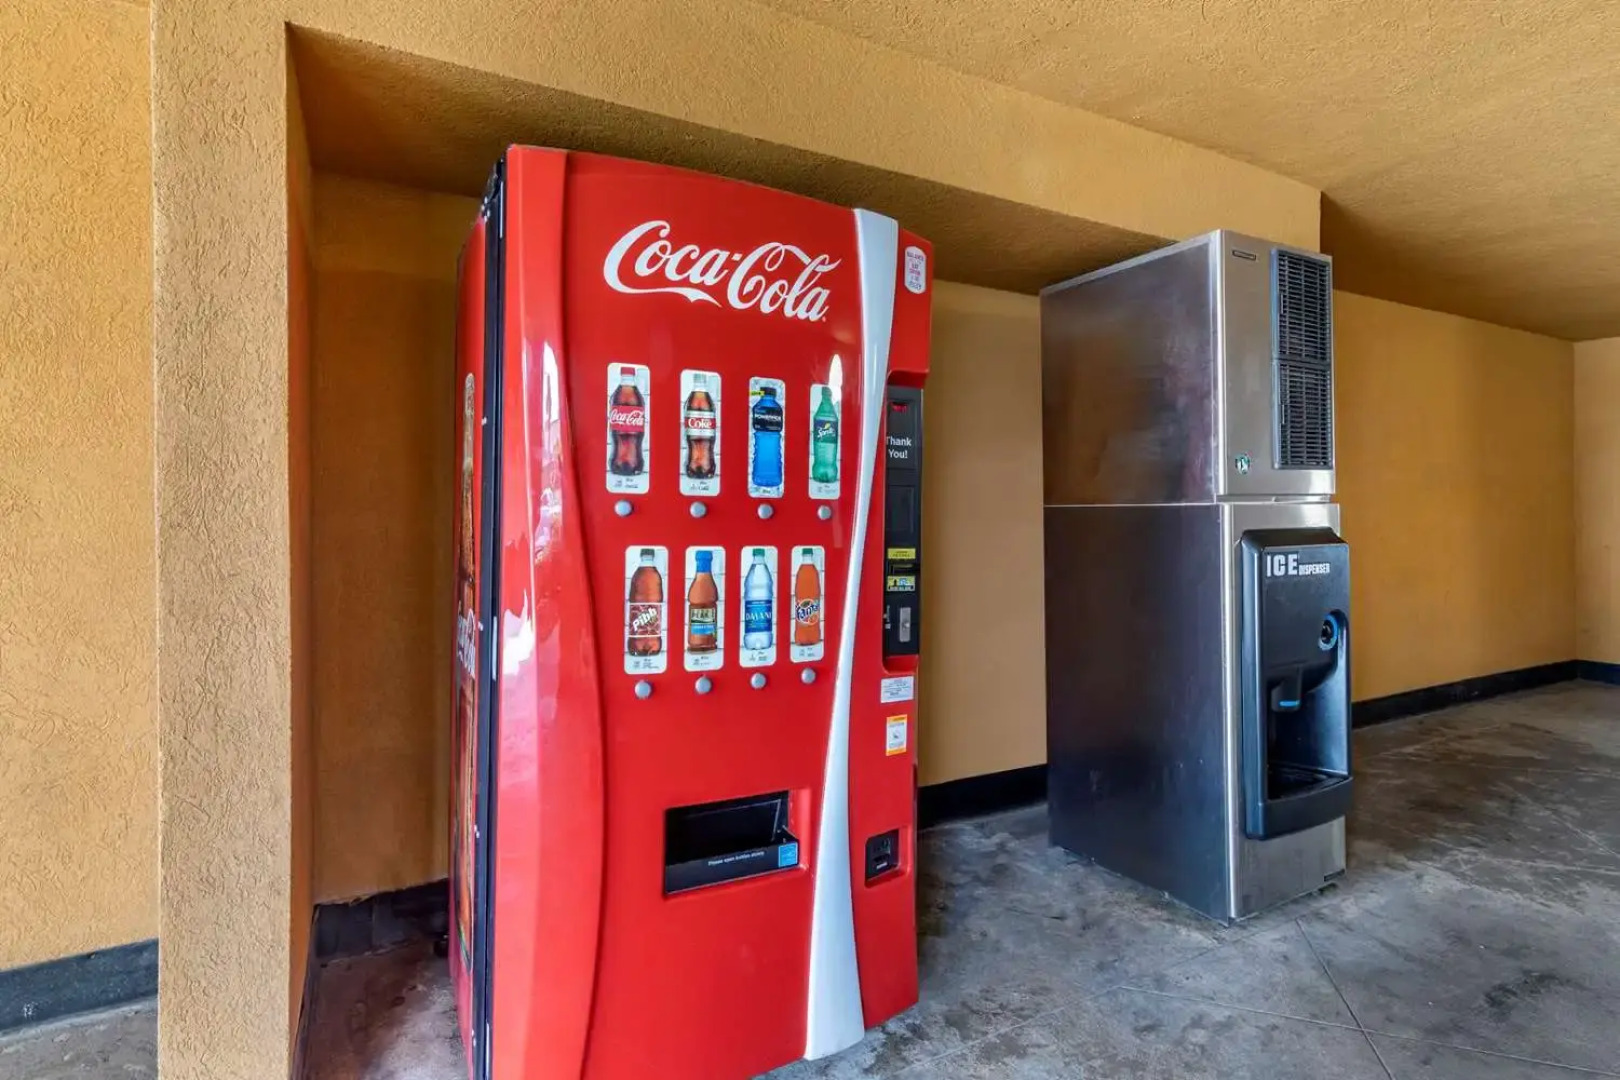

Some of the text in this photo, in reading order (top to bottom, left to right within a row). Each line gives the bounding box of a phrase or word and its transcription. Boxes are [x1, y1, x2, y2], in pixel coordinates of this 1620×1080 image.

[603, 220, 842, 322] Coca-Cola
[610, 408, 644, 427] Coca-Cola
[687, 417, 712, 429] Coke
[886, 435, 912, 446] Thank
[888, 449, 908, 459] You!
[1266, 554, 1330, 577] ICE DISPENSER
[632, 606, 657, 632] Pibb
